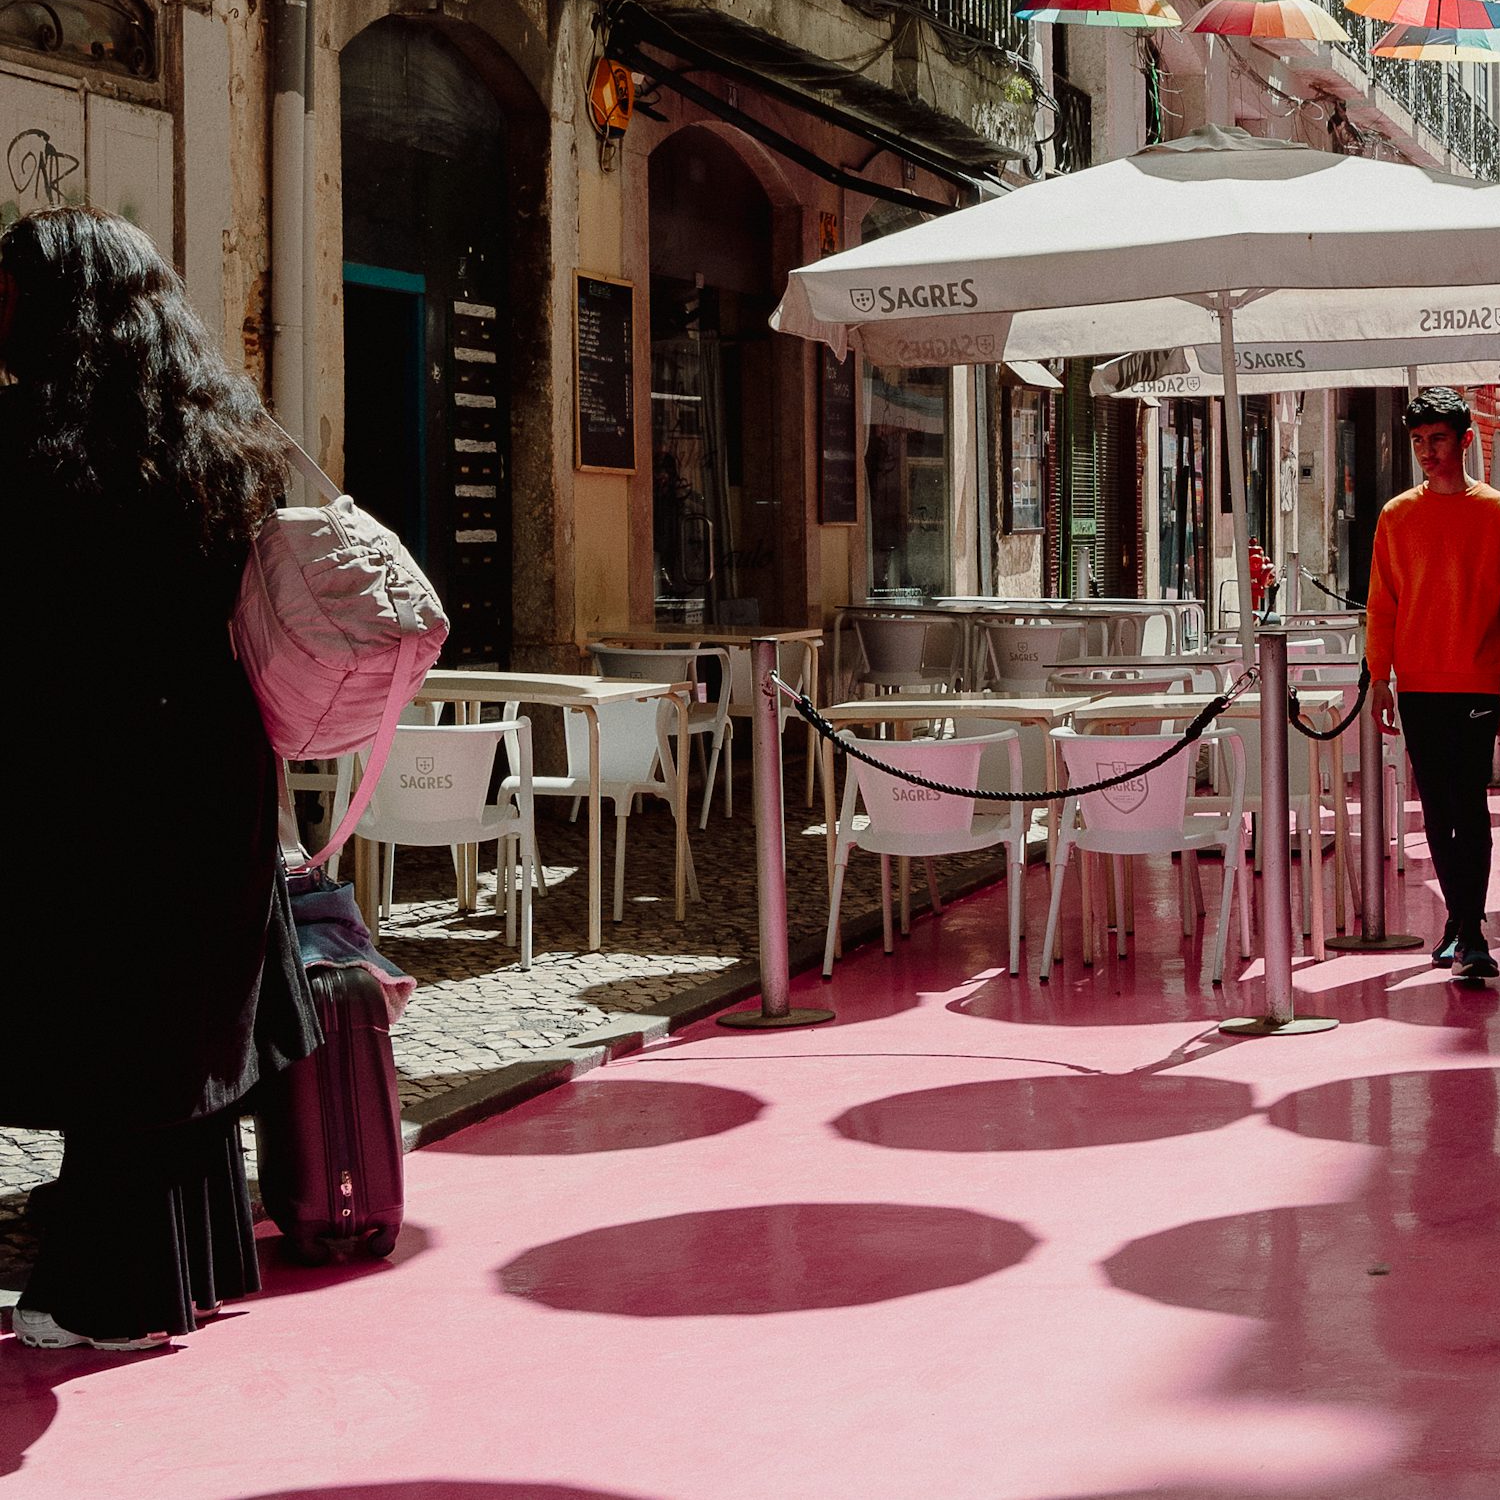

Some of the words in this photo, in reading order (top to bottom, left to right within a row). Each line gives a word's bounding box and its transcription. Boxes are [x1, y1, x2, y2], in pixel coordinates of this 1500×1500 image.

[878, 278, 978, 313] SAGRES
[1243, 349, 1306, 370] SAGRES
[1009, 652, 1039, 662] SAGRES
[400, 774, 453, 789] SAGRES
